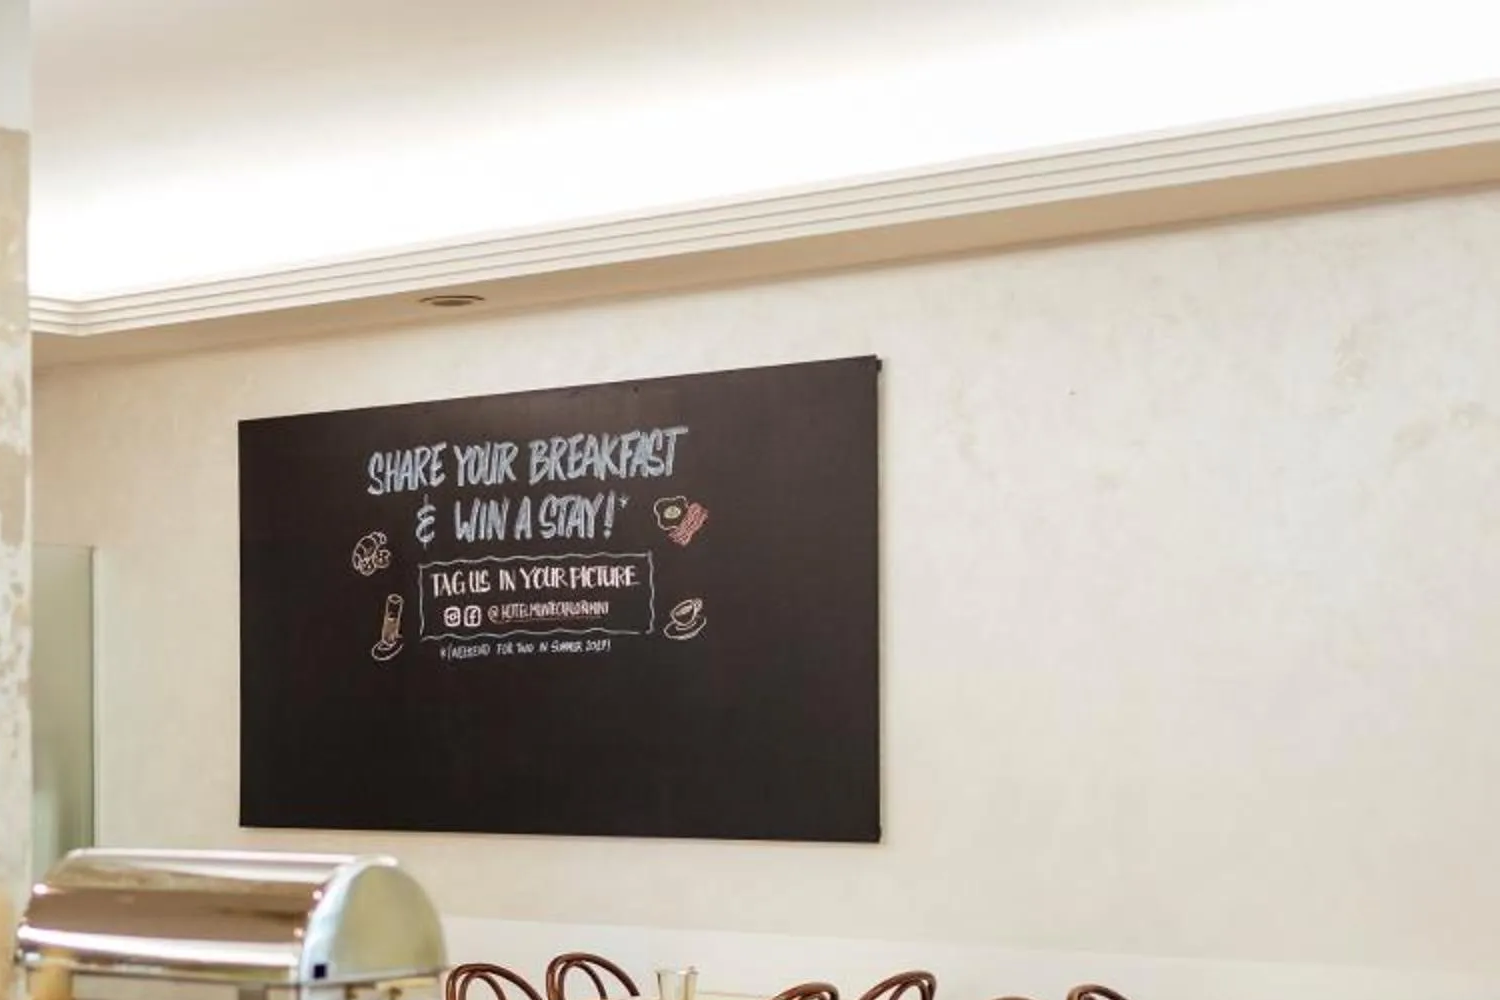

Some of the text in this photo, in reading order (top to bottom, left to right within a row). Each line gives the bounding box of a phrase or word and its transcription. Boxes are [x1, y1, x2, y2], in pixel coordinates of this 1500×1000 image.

[366, 426, 689, 495] SHARE YOUR BREAKFAST
[415, 494, 437, 550] &
[454, 497, 510, 542] WIN
[514, 496, 532, 540] A
[430, 565, 640, 597] TAG US IN YOUR PICTURE
[539, 641, 548, 653] IN
